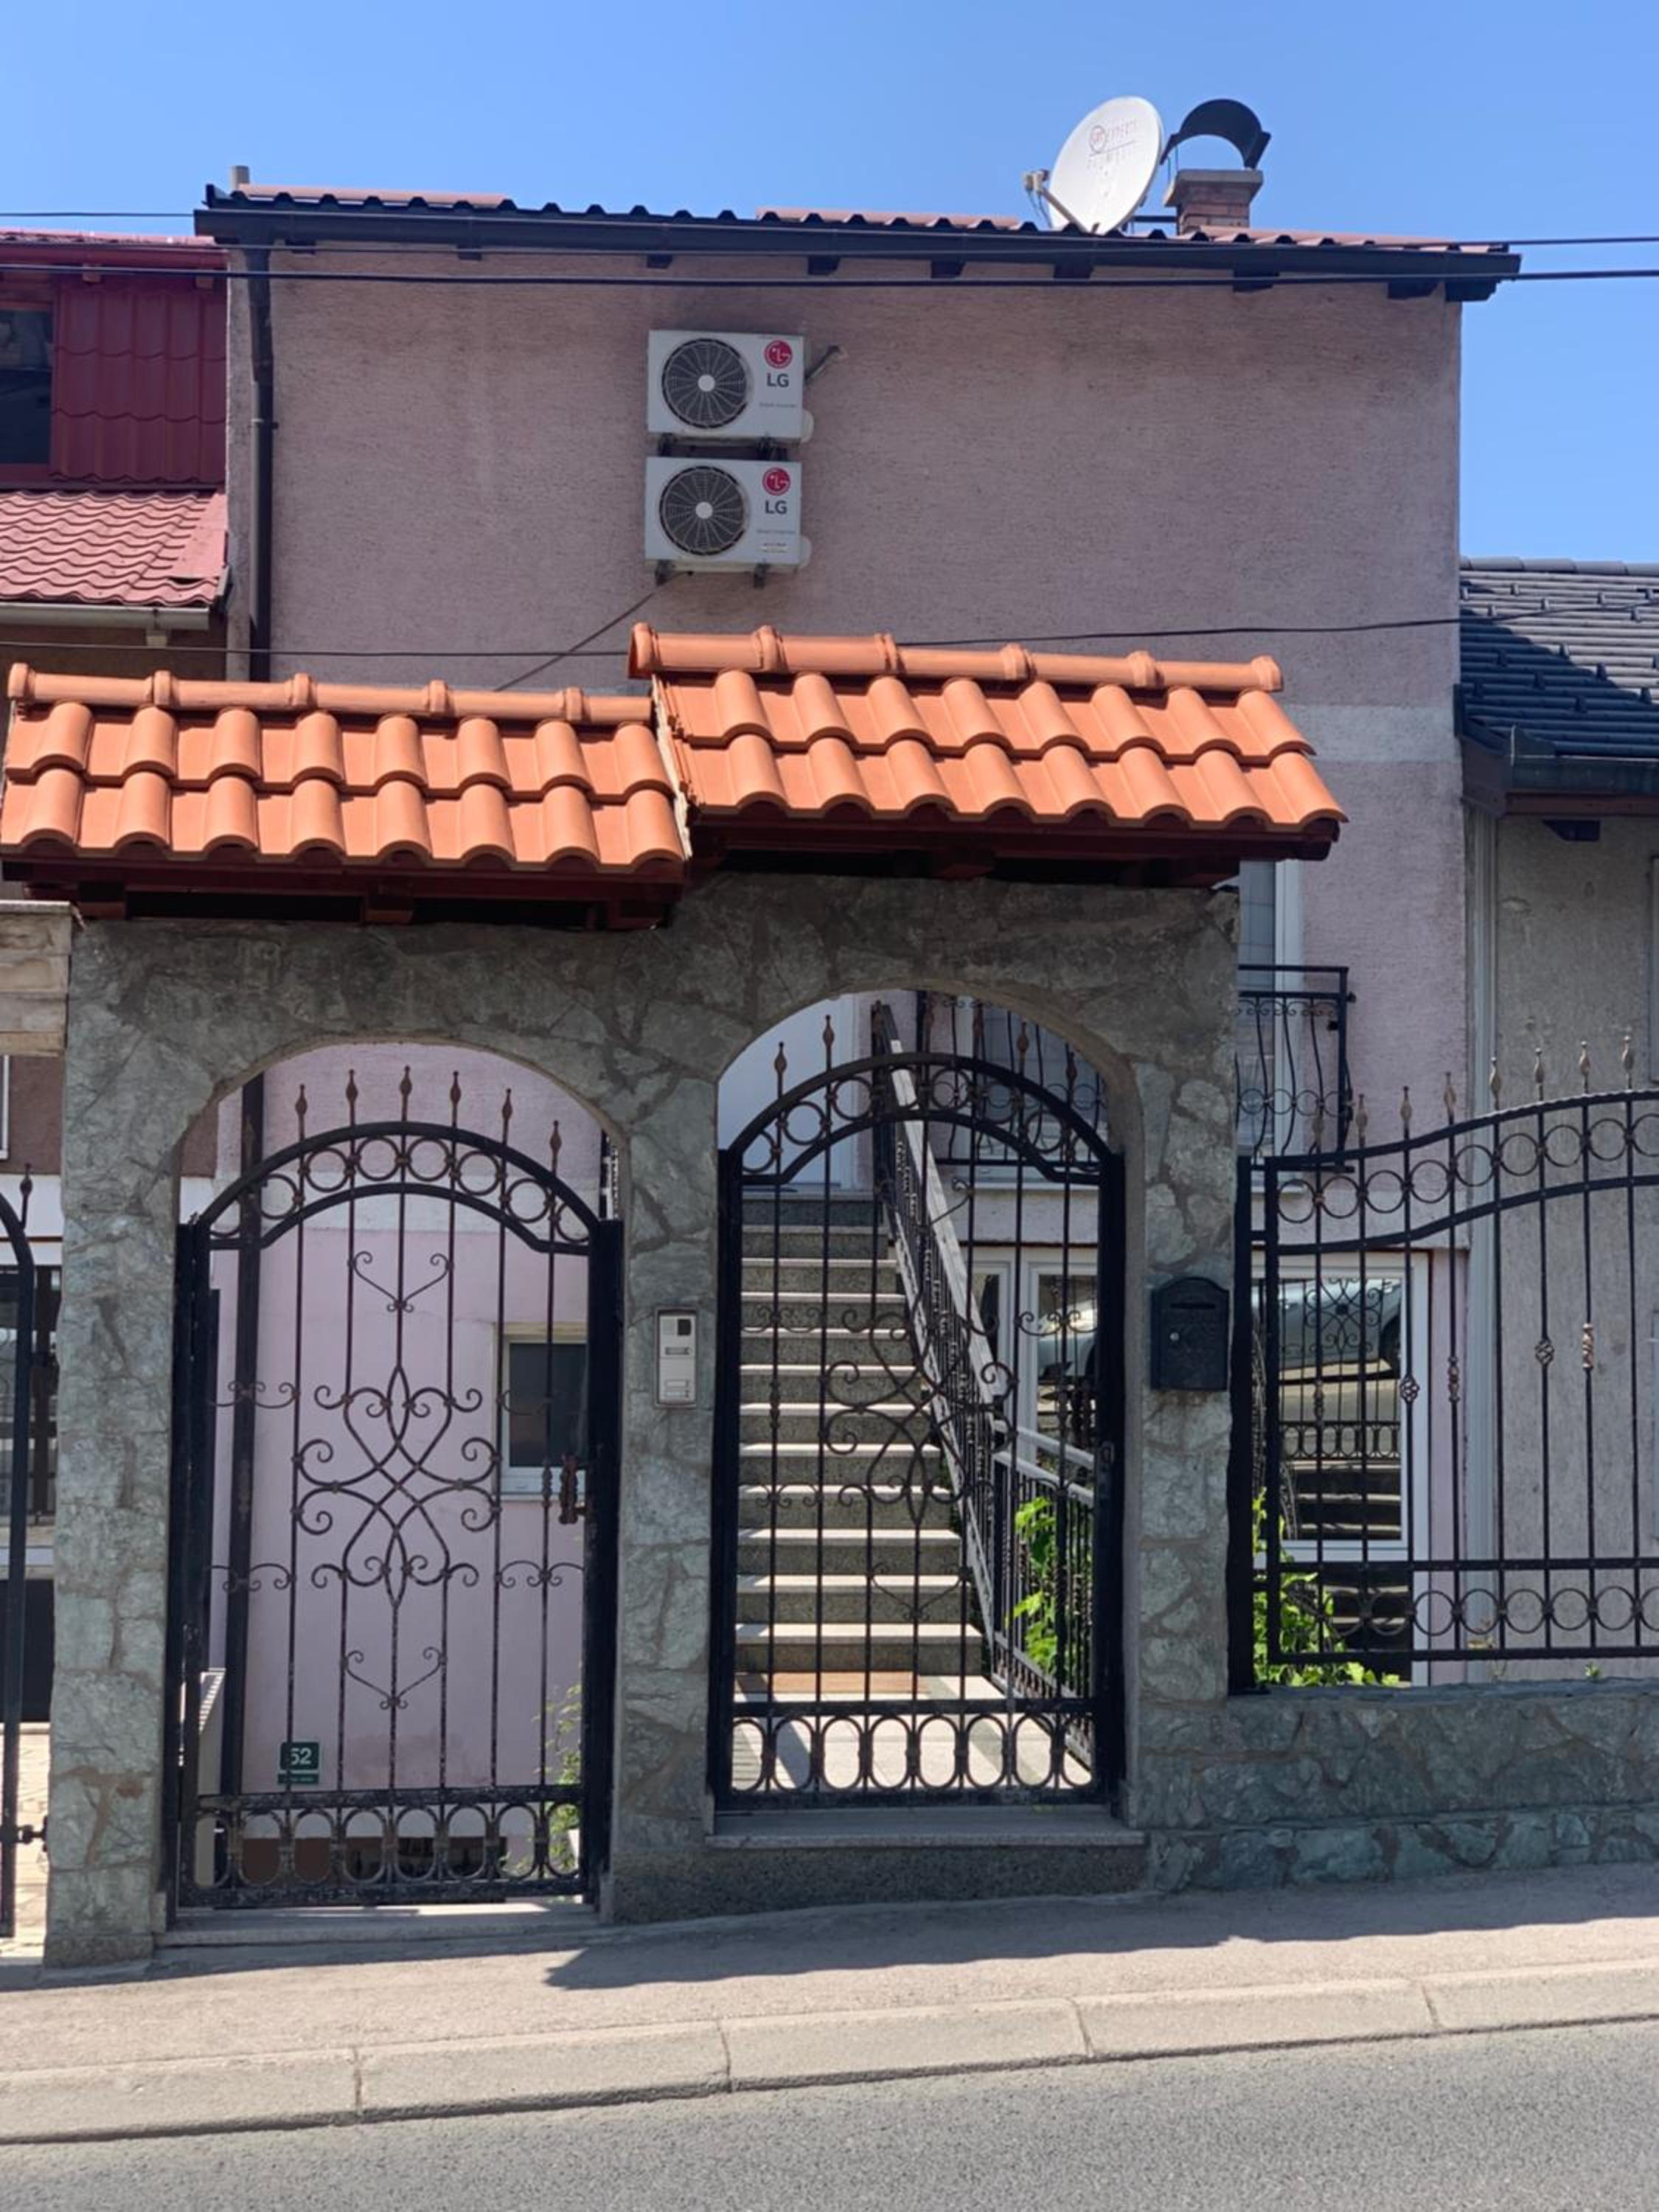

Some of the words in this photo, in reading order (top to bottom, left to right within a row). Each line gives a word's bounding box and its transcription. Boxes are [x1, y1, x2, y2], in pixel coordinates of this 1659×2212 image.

[767, 373, 789, 388] LG
[765, 500, 787, 515] LG
[290, 1747, 312, 1764] 52
